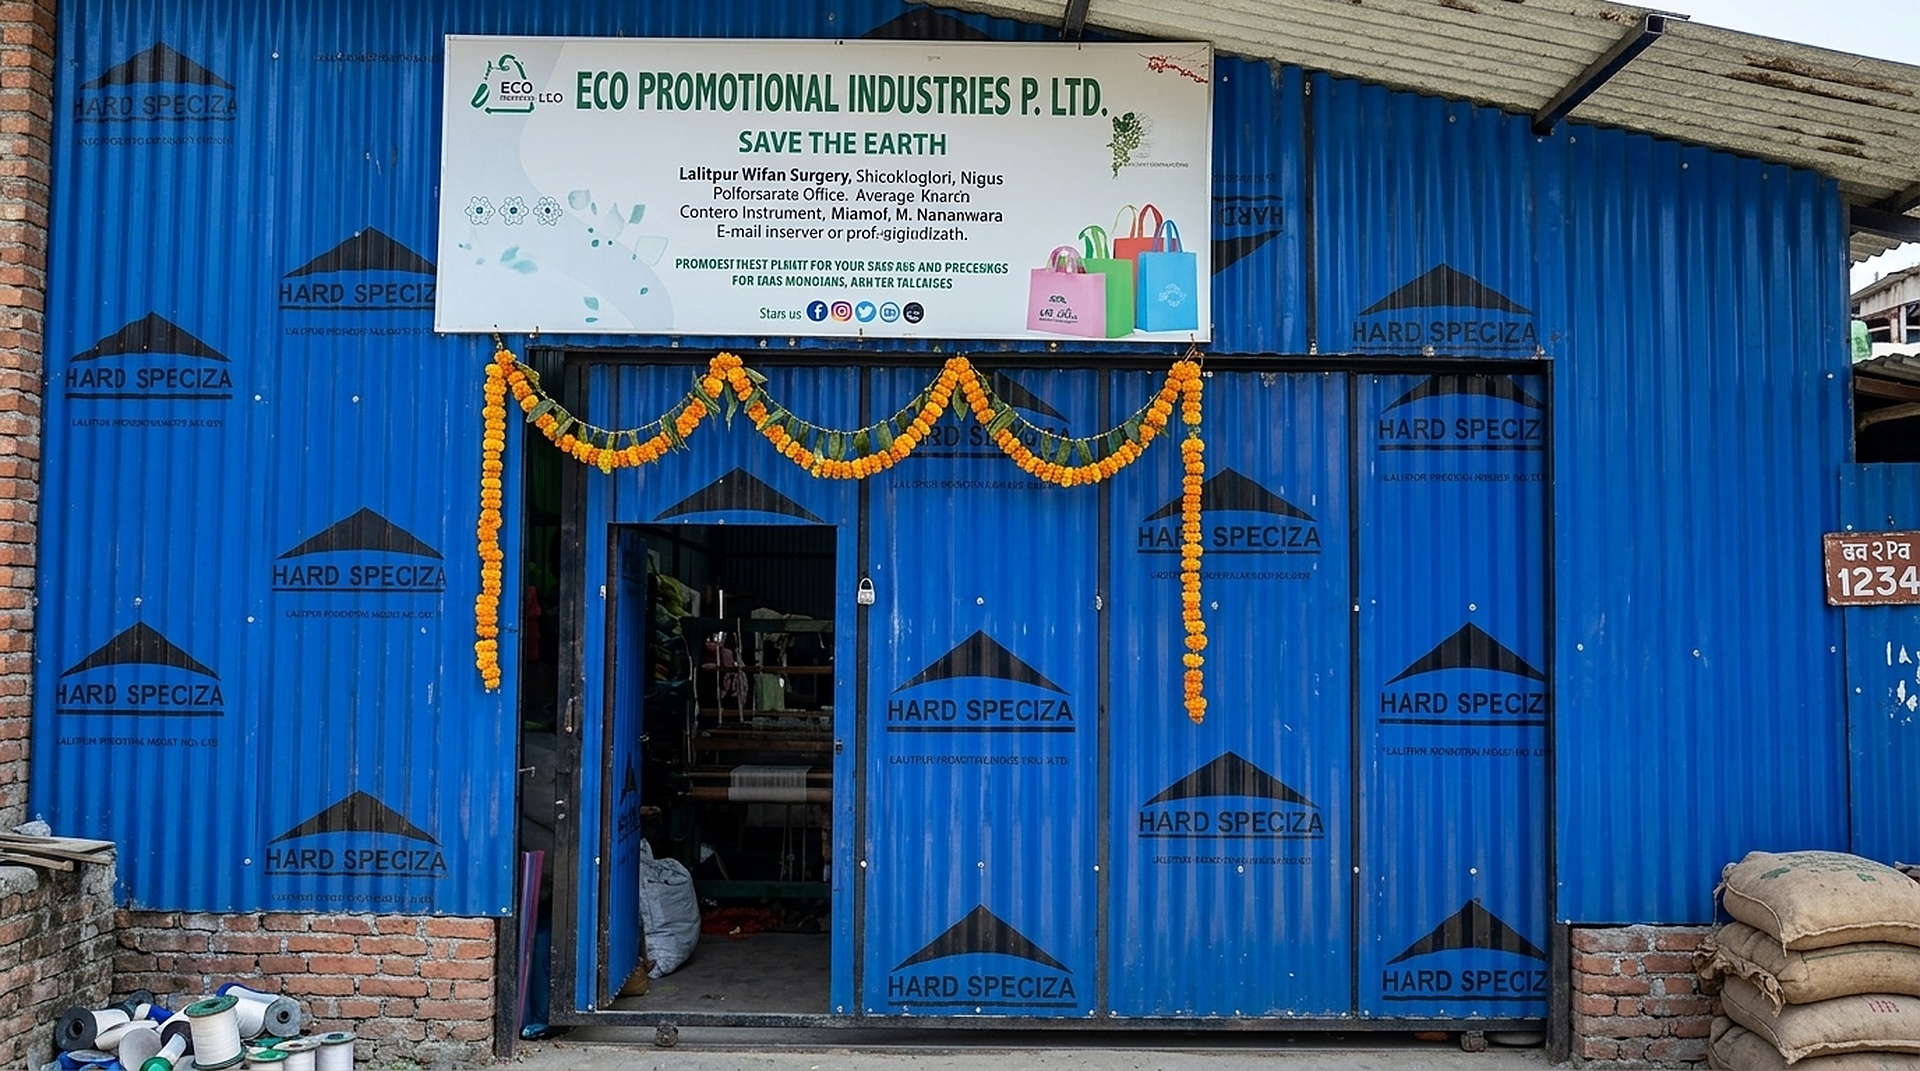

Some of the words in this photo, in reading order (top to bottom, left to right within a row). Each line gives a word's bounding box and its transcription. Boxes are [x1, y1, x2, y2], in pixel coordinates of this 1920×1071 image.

[501, 82, 533, 94] ECO
[577, 71, 629, 111] ECO
[638, 72, 839, 114] PROMOTIONAL
[848, 74, 1011, 116] INDUSTRIES
[1021, 78, 1041, 117] P.
[1051, 78, 1108, 117] LTD.
[74, 96, 133, 115] HARD
[143, 95, 238, 116] SPECIZA
[738, 130, 801, 153] SAVE
[809, 131, 856, 154] THE
[864, 133, 947, 156] EARTH
[679, 167, 738, 183] Lalitpur
[742, 167, 786, 181] Wifan
[790, 168, 852, 185] Surgery,
[856, 169, 956, 187] Shicokloglori,
[960, 171, 1004, 188] Nigus
[713, 186, 799, 201] Polforsarate
[803, 187, 849, 201] Office.
[856, 189, 915, 205] Average
[680, 205, 738, 219] Contero
[742, 206, 826, 222] Instrument,
[831, 207, 892, 222] Miamof,
[896, 208, 913, 221] M.
[917, 208, 1004, 223] Nananwara
[717, 225, 761, 238] E-mail
[766, 225, 824, 239] inserver
[828, 228, 843, 239] or
[810, 261, 832, 271] FOR
[834, 261, 865, 271] YOUR
[917, 262, 942, 273] AND
[732, 275, 754, 286] FOR
[280, 284, 344, 304] HARD
[355, 283, 435, 304] SPECIZ
[759, 307, 786, 320] Stars
[789, 310, 802, 320] us
[1352, 321, 1421, 343] HARD
[1430, 321, 1537, 343] SPECIZA
[66, 368, 126, 389] HARD
[136, 368, 233, 389] SPECIZA
[1379, 418, 1445, 440] HARD
[1455, 418, 1541, 440] SPECIZ
[1138, 527, 1187, 548] HAR
[1213, 526, 1321, 548] SPECIZA
[272, 565, 339, 586] HARD
[349, 565, 447, 586] SPECIZA
[1837, 566, 1920, 597] 1234
[56, 685, 117, 706] HARD
[127, 685, 224, 707] SPECIZA
[1380, 692, 1448, 714] HARD
[1457, 692, 1544, 714] SPECIZ
[888, 699, 957, 722] HARD
[966, 699, 1074, 722] SPECIZA
[1139, 811, 1209, 833] HARD
[1218, 811, 1324, 833] SPECIZA
[266, 849, 334, 870] HARD
[343, 849, 447, 871] SPECIZA
[888, 976, 959, 999] HARD
[967, 976, 1076, 999] SPECIZA
[1382, 970, 1451, 992] HARD
[1461, 970, 1547, 992] SPECIZ
